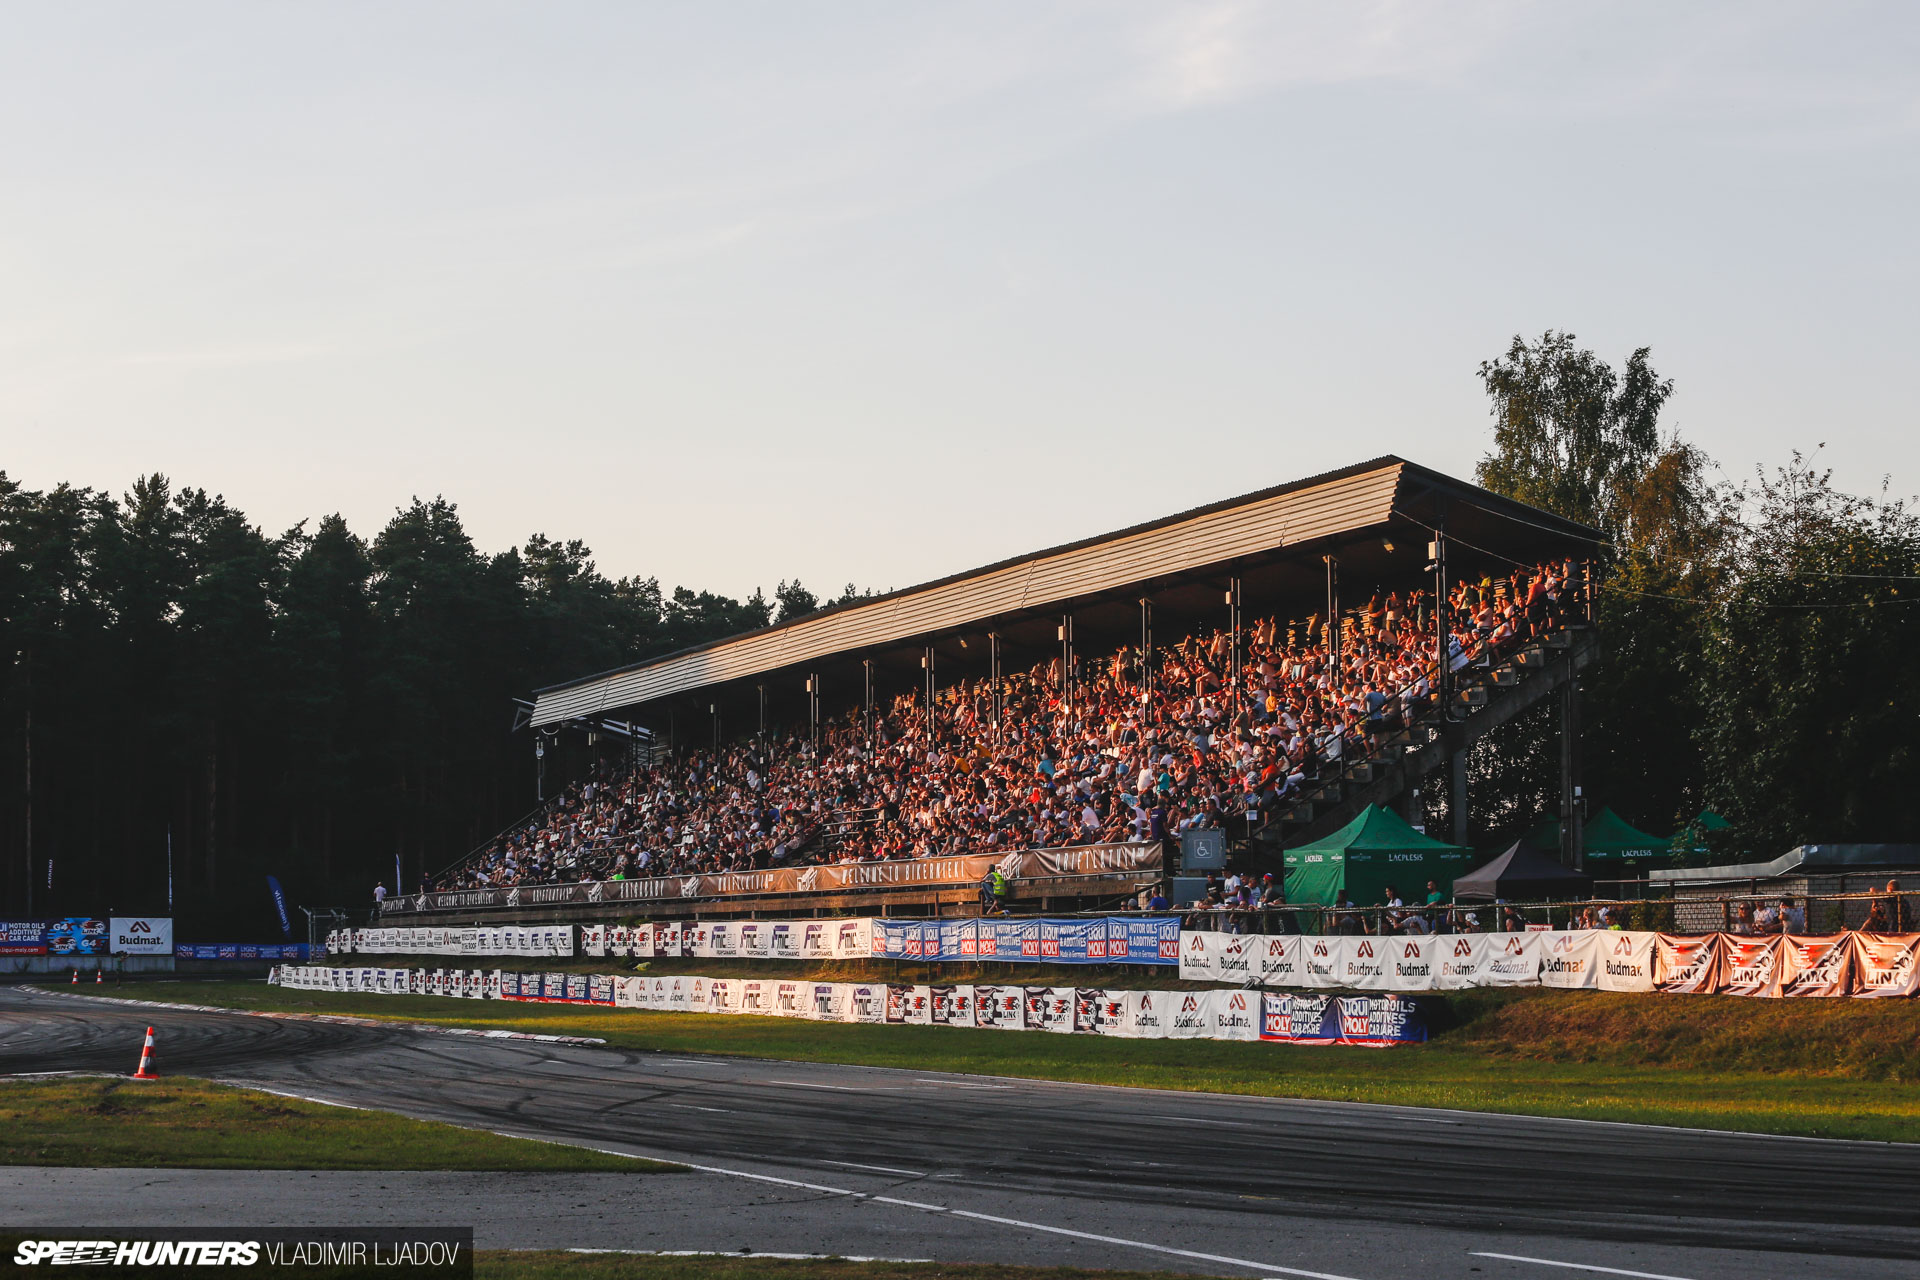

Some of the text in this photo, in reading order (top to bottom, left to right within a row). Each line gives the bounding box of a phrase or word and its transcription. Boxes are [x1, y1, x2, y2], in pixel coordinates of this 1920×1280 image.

[889, 866, 899, 881] TO
[1109, 925, 1127, 938] LIQUI
[1129, 924, 1144, 934] MOTOR
[1160, 926, 1178, 940] LIQUI
[119, 935, 164, 944] Budmat.
[1022, 941, 1038, 954] MOLY
[1042, 941, 1058, 955] MOLY
[1088, 941, 1106, 956] MOLY
[1109, 941, 1127, 955] MOLY
[1160, 942, 1179, 957] MOLY
[1267, 1000, 1290, 1014] LIQUI
[1344, 1001, 1368, 1016] LIQUI
[1390, 1000, 1416, 1012] OILS
[1266, 1016, 1290, 1031] MOLY
[1344, 1017, 1368, 1033] MOLY
[1381, 1024, 1401, 1036] ARE
